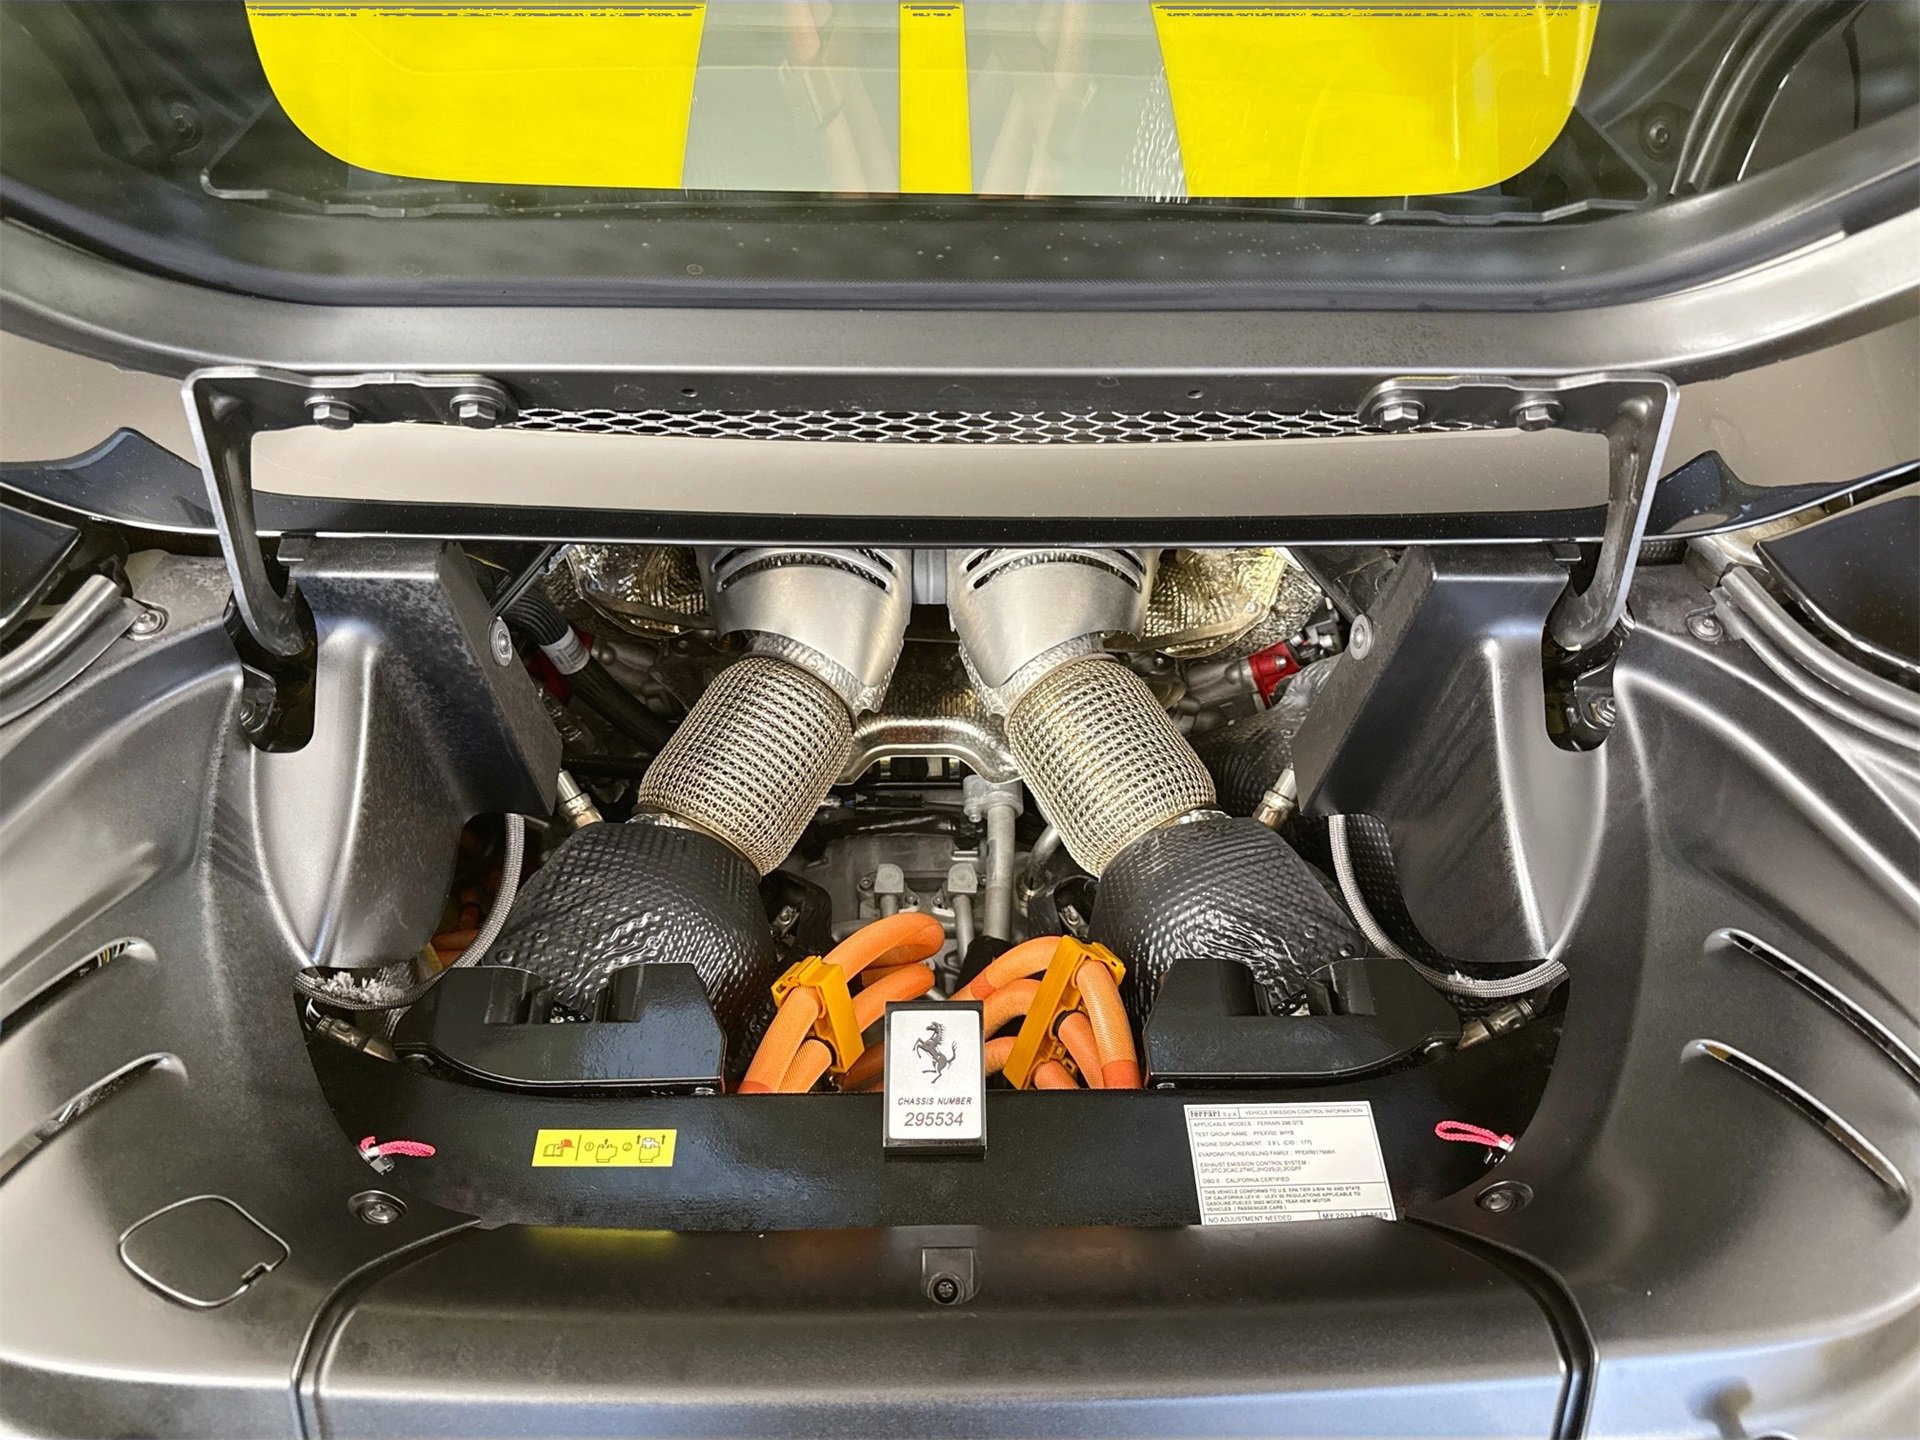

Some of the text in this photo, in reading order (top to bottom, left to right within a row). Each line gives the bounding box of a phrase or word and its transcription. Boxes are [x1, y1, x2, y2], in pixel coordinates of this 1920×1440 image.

[898, 1097, 972, 1105] CHASSIS NUMBER
[904, 1112, 964, 1126] 295534
